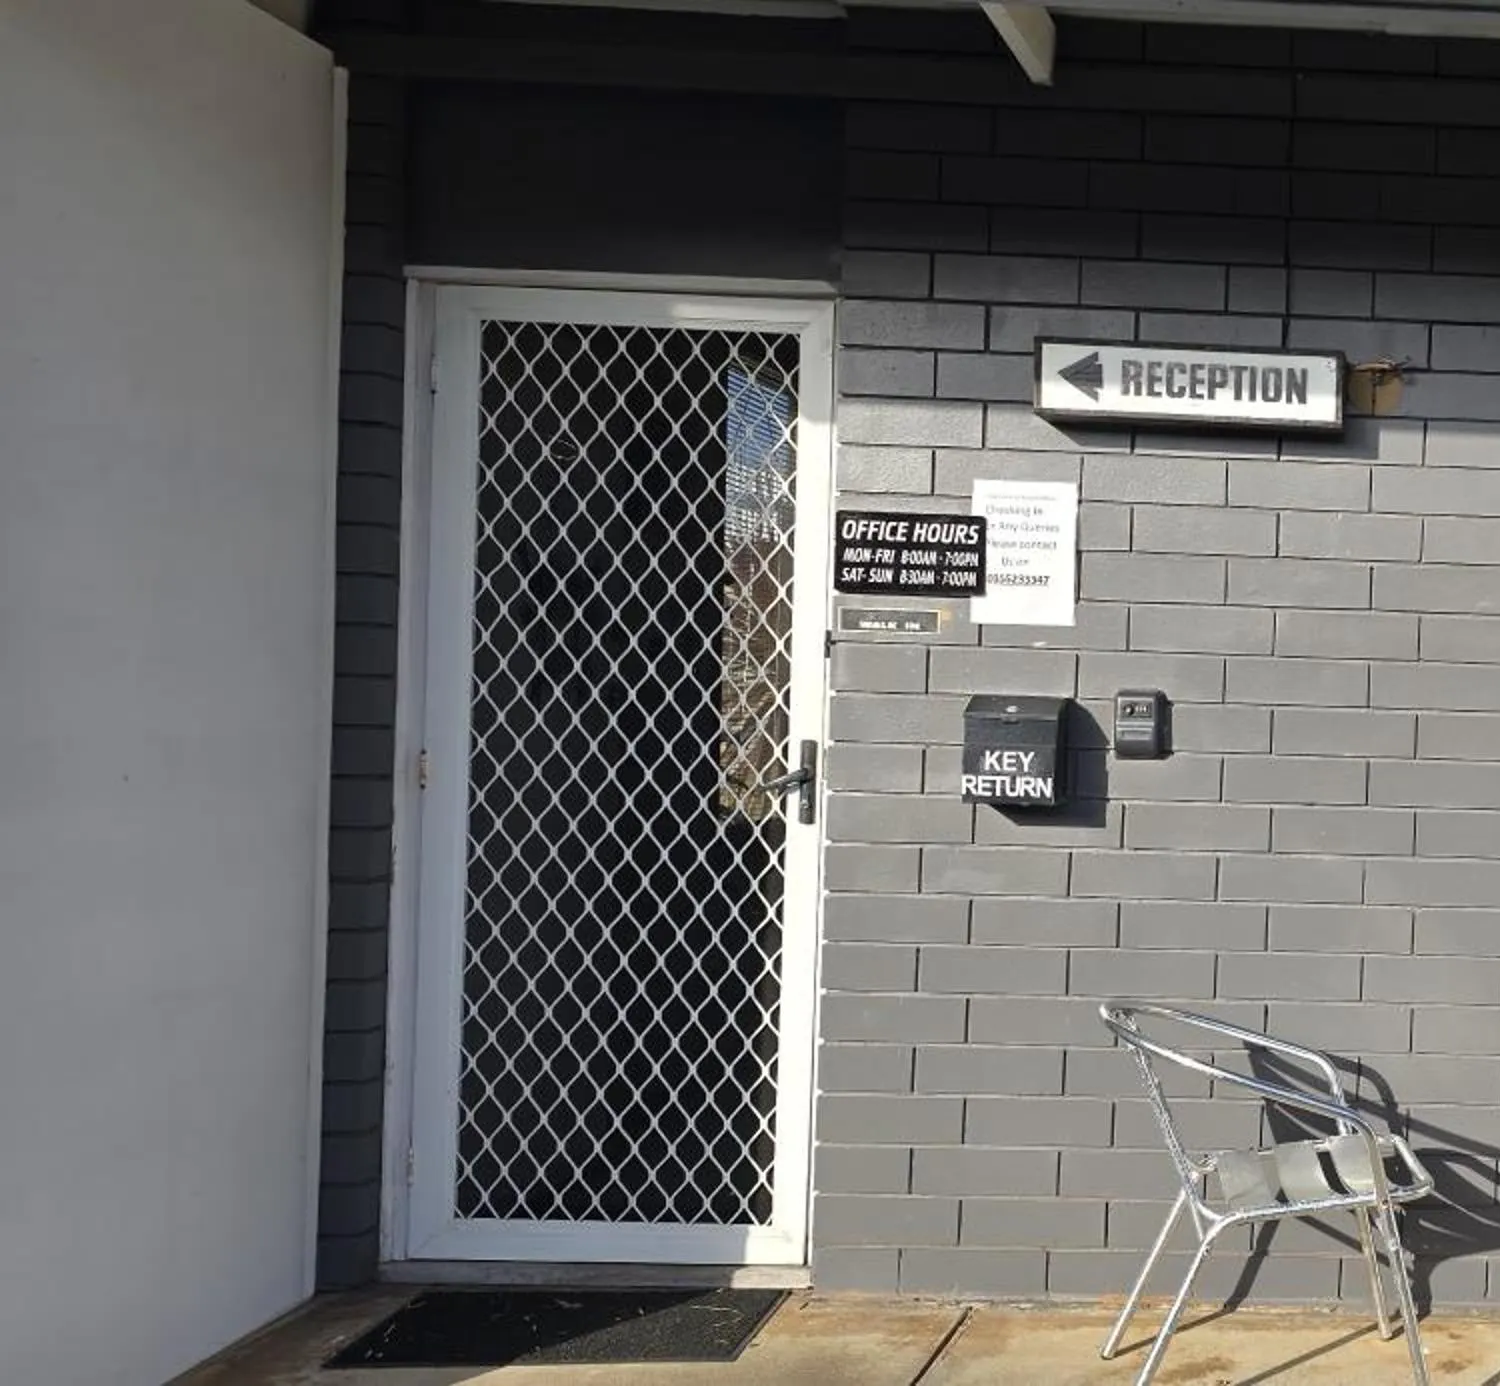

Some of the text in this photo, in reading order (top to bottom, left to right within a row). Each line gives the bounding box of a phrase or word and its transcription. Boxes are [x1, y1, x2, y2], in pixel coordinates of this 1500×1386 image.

[1121, 358, 1308, 405] RECEPTION
[842, 519, 980, 545] OFFICE HOURS
[843, 547, 896, 564] MON-FRI
[901, 550, 937, 566] 8:00AM
[945, 551, 979, 567] 7:00PM
[900, 569, 935, 585] 8:30AM
[942, 571, 977, 587] 7:00PM
[984, 750, 1035, 773] KEY
[961, 774, 1053, 799] RETURN
